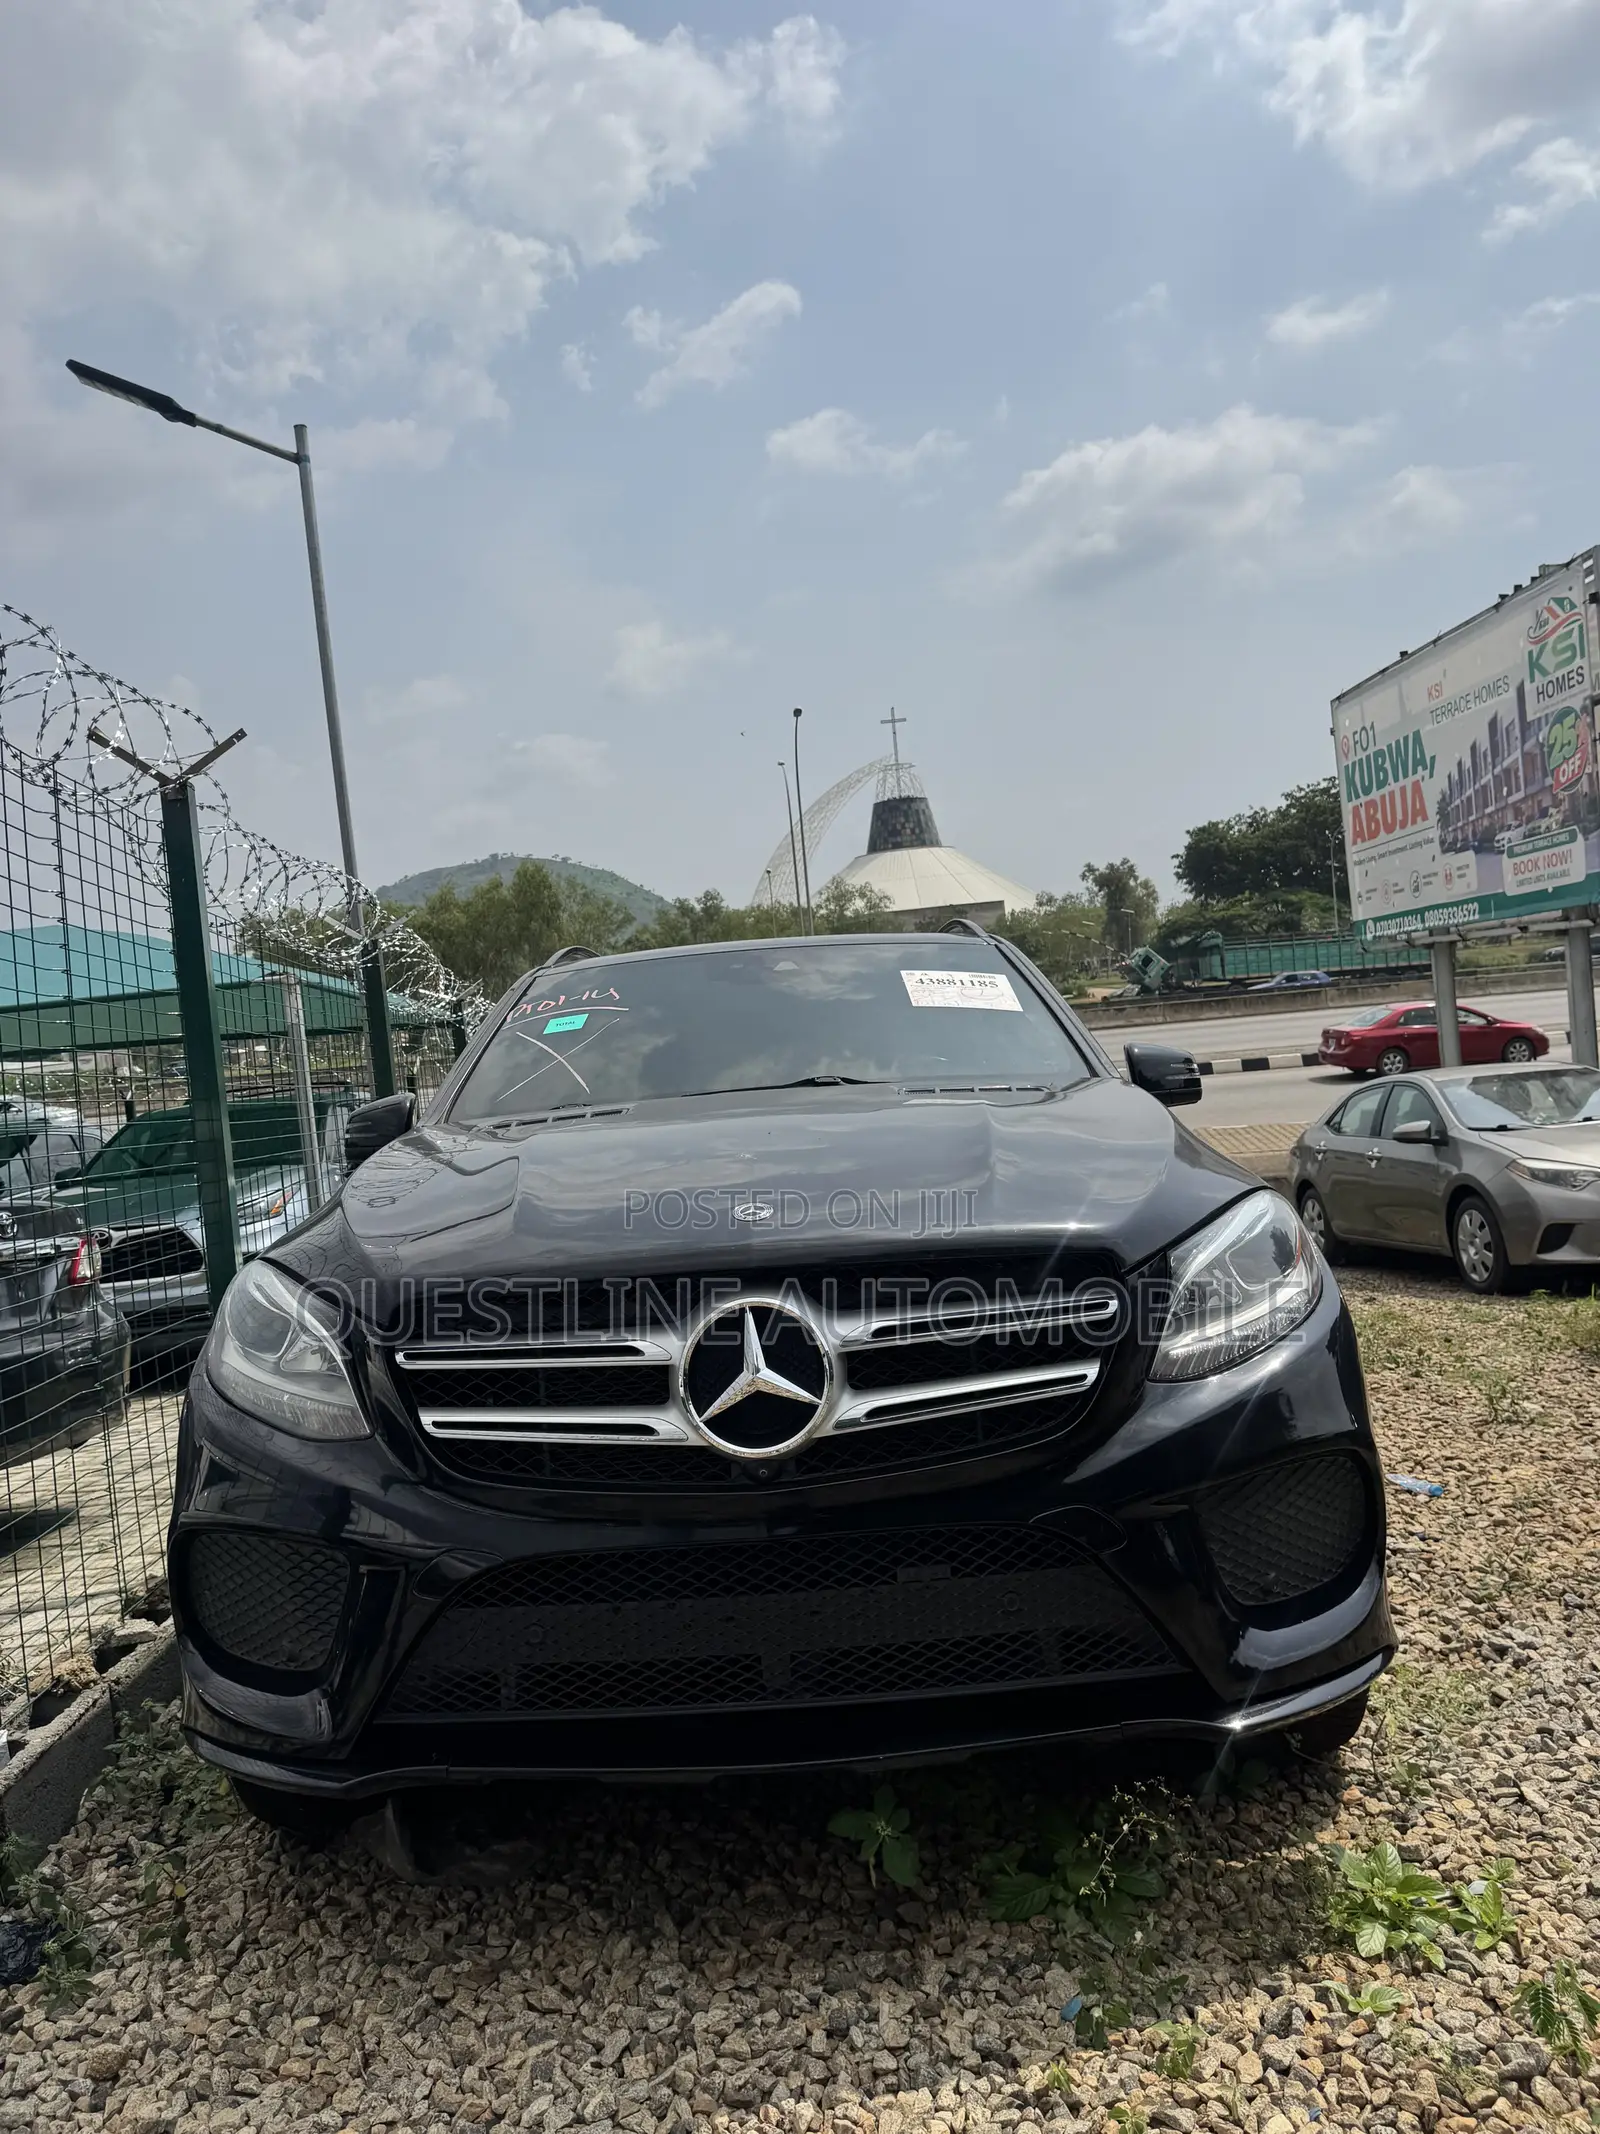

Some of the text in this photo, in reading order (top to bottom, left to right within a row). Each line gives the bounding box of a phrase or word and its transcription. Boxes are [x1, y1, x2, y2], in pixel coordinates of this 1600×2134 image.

[1527, 622, 1586, 684] KSI
[1427, 680, 1444, 703] KSI
[1429, 693, 1472, 726] TERRACE
[1473, 675, 1511, 707] HOMES
[1536, 665, 1585, 704] HOMES
[1344, 728, 1436, 803] KUBWA,
[1560, 751, 1582, 783] OFF
[1351, 779, 1429, 846] ABUJA
[1513, 848, 1573, 876] BOOK NOW!
[915, 977, 999, 989] 43881185
